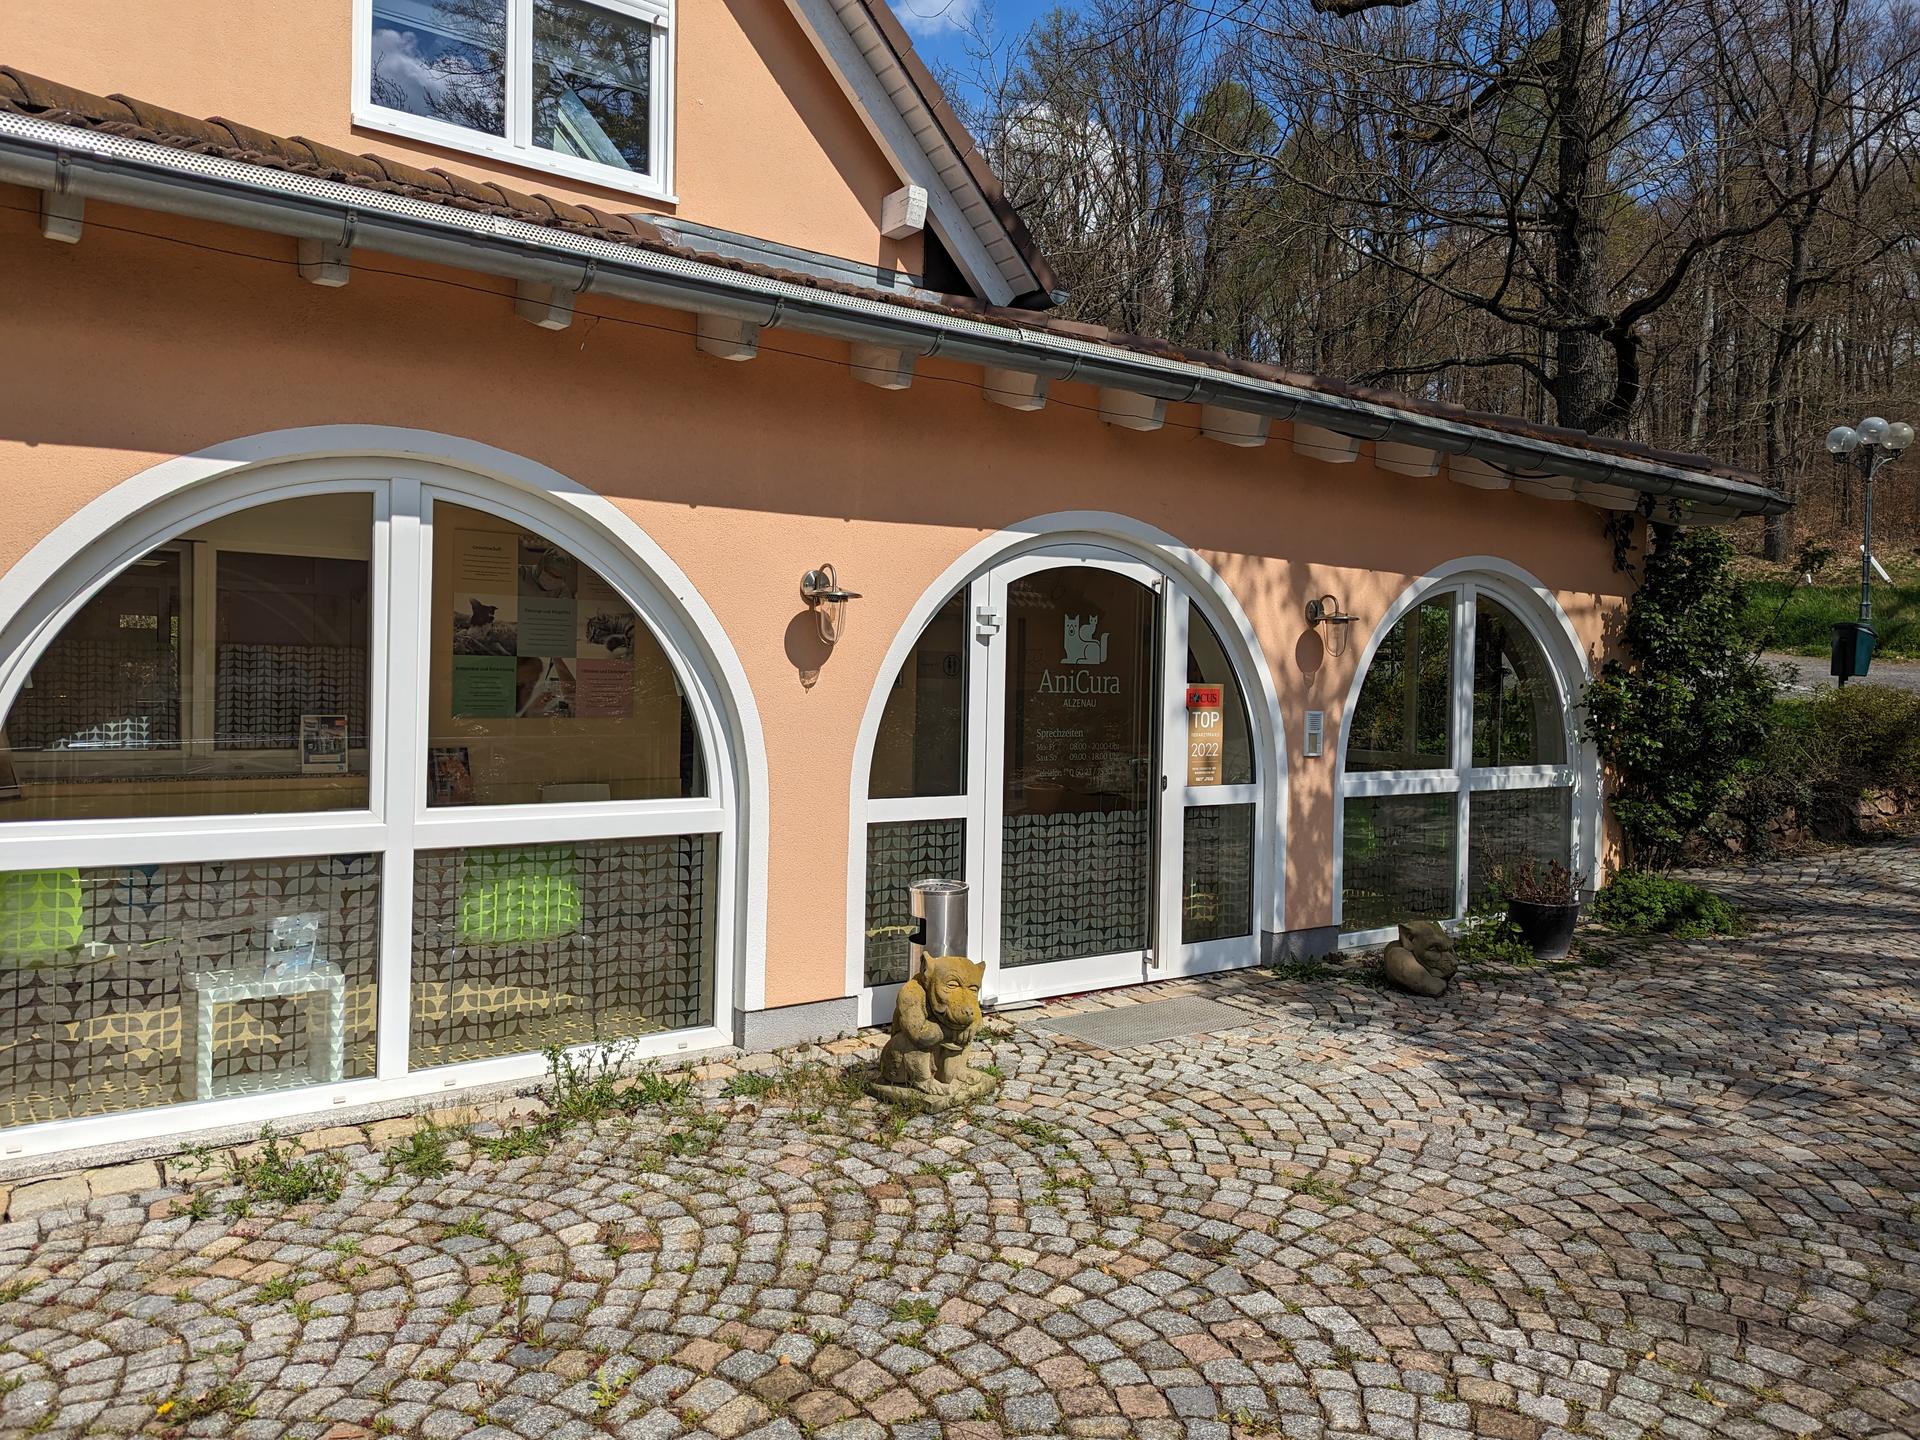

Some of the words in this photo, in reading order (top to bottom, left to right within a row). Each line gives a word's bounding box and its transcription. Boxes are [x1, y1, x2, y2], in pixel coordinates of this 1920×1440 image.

[1037, 668, 1120, 694] AniCura
[1063, 698, 1097, 708] ALZENAU
[1191, 711, 1220, 729] TOP
[1036, 728, 1084, 739] Sprechzeiten
[1191, 742, 1219, 757] 2022
